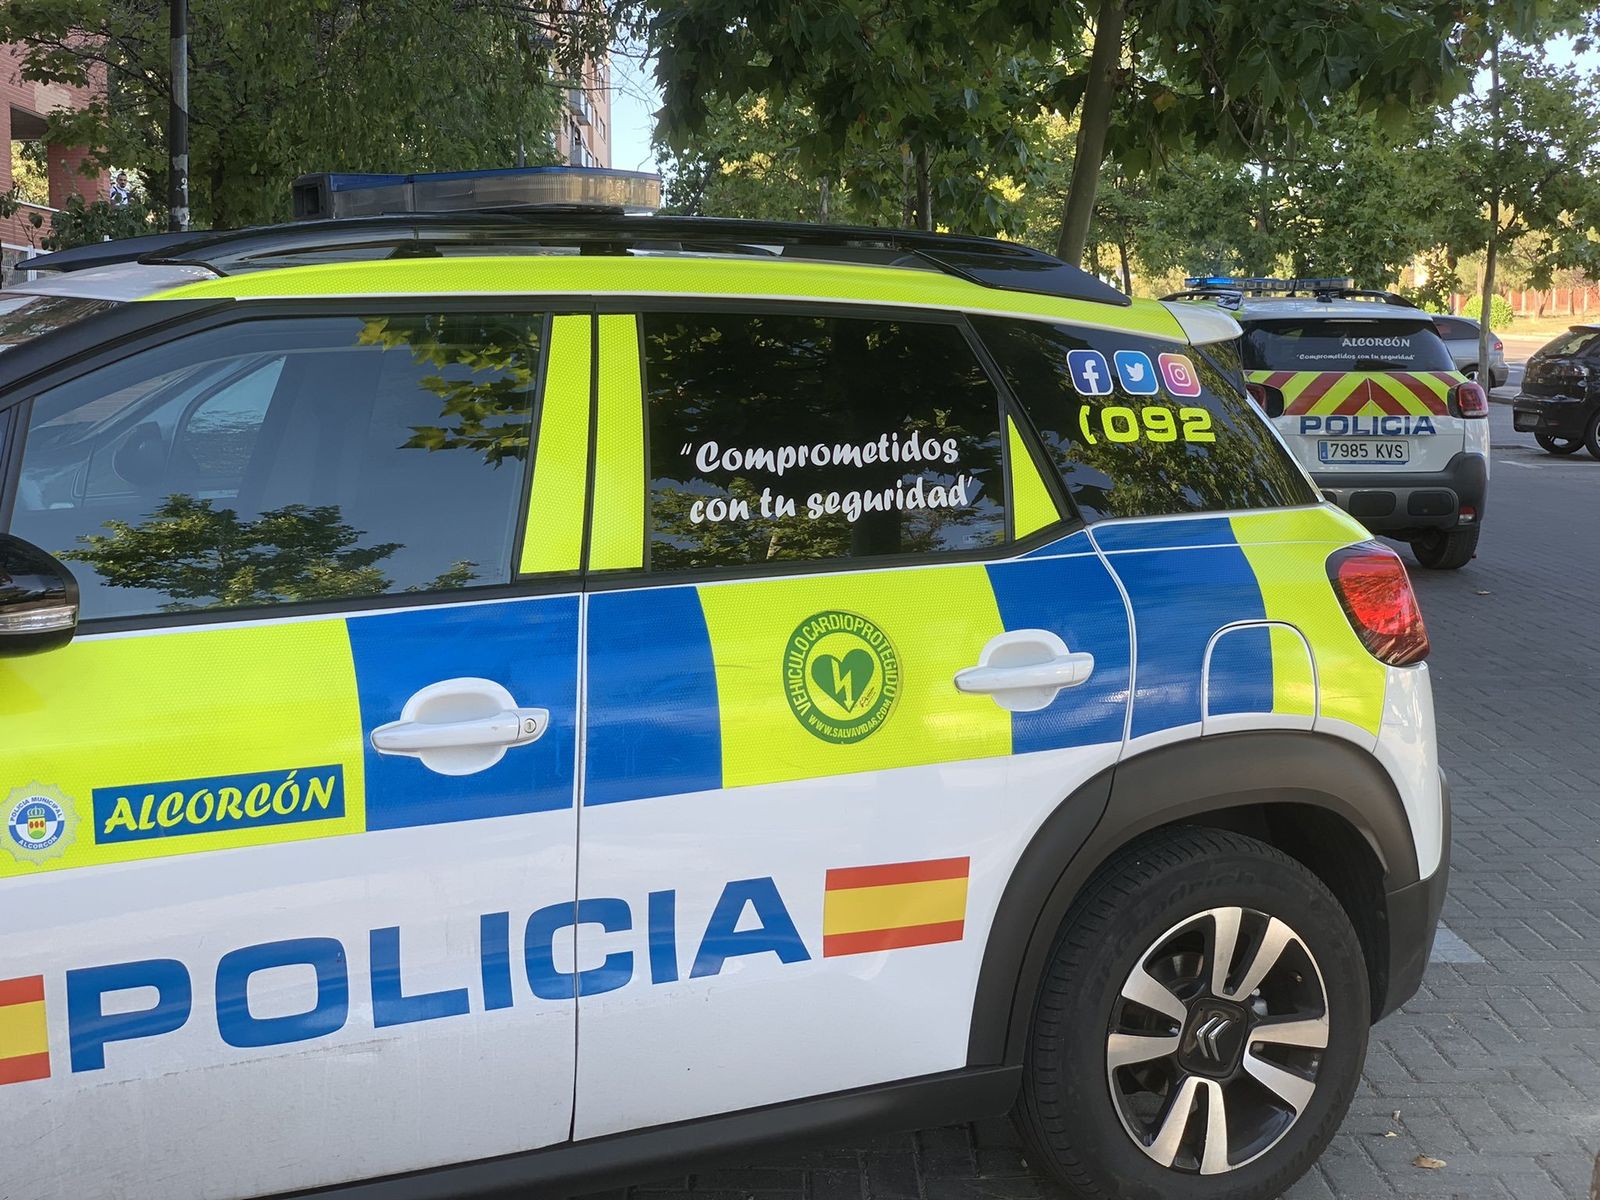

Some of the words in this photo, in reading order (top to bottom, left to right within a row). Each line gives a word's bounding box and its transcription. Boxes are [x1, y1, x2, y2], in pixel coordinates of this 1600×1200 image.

[1342, 336, 1411, 347] ALCORCÓN
[1101, 406, 1217, 442] 092
[1300, 415, 1437, 435] POLICIA
[1330, 443, 1368, 458] 7985
[1376, 443, 1403, 458] KVS
[689, 498, 750, 524] con
[760, 487, 796, 519] tu
[788, 636, 812, 716] VEHICULO
[802, 614, 897, 697] CARDIOPROTEGIDO
[808, 699, 892, 738] WWW.SALVAVIDAS.COM
[10, 799, 30, 822] POLICIA
[31, 796, 63, 818] MUNICIPAL
[103, 770, 336, 834] ALCORCÓN
[66, 876, 812, 1073] POLICIA
